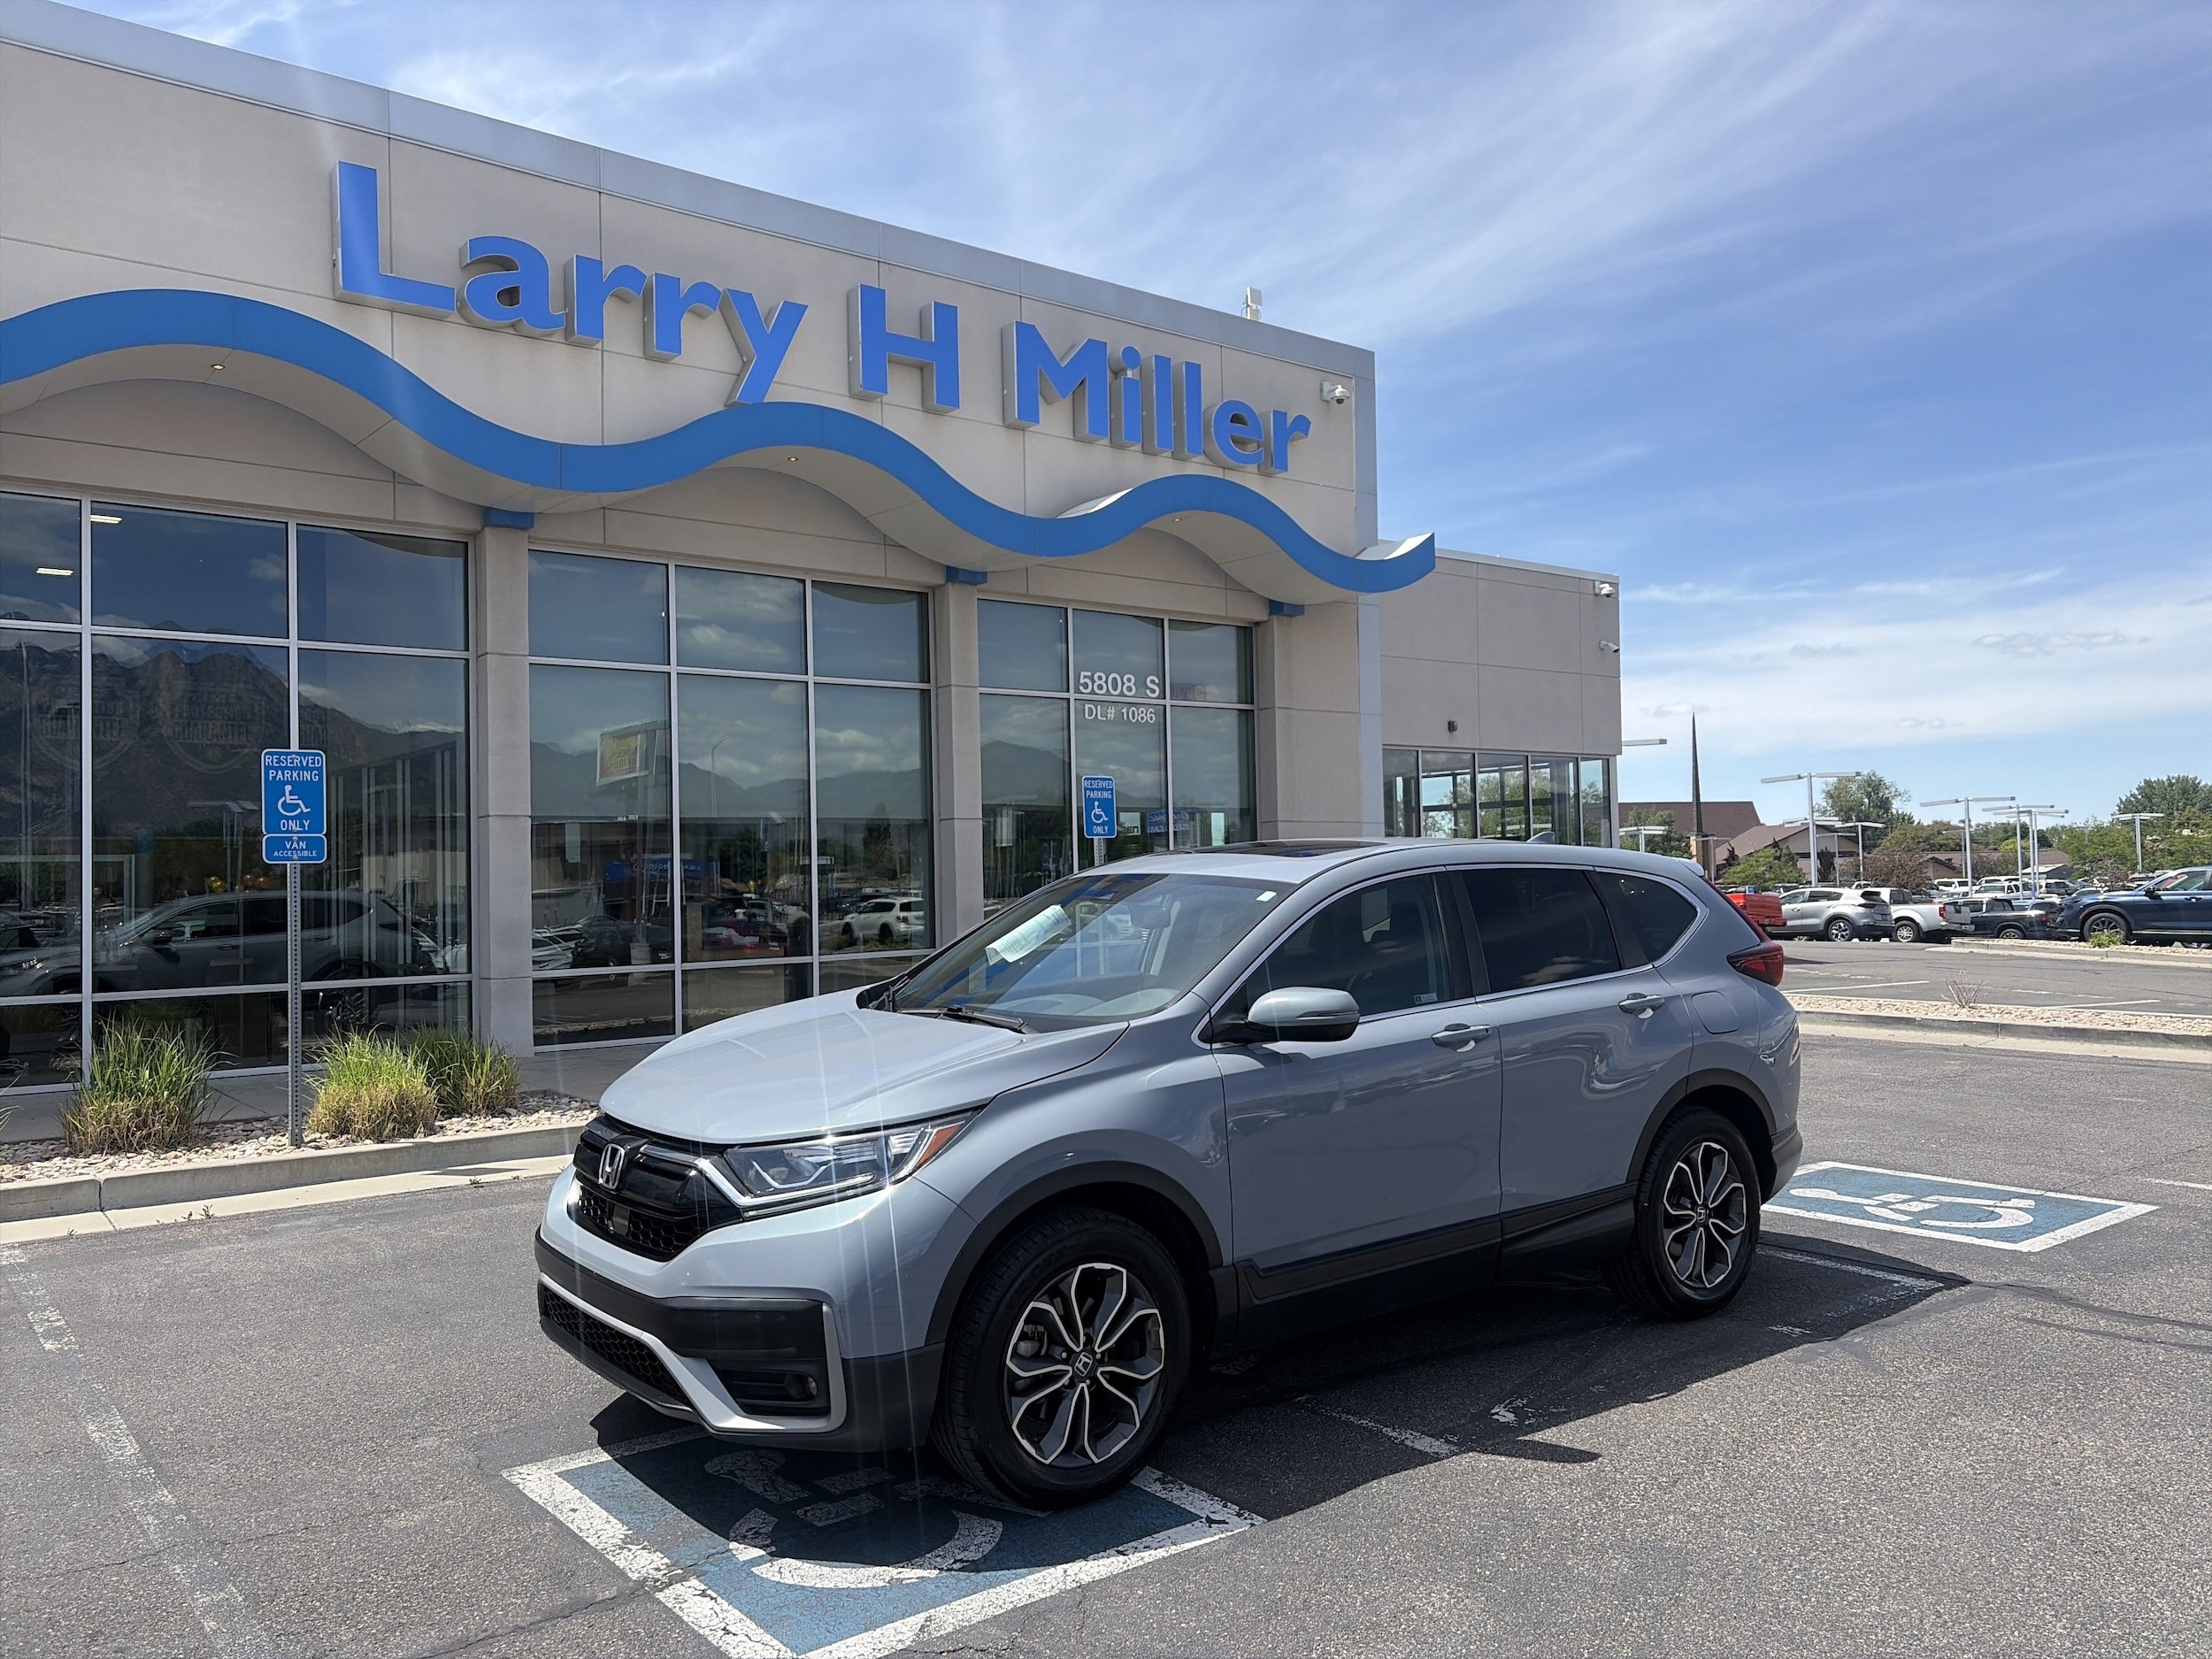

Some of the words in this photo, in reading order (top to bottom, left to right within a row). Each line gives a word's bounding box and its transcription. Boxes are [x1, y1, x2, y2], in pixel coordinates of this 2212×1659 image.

[331, 159, 809, 407] Larry
[848, 283, 960, 413] H
[1002, 320, 1312, 472] Miller
[1079, 671, 1136, 696] 5808
[1146, 675, 1160, 698] S
[1084, 703, 1115, 721] DL#
[1121, 707, 1156, 724] 1086
[265, 755, 322, 767] RESERVED
[269, 770, 319, 782] PARKING
[1084, 780, 1113, 788] RESERVED
[1086, 790, 1112, 799] PARKING
[280, 819, 311, 831] ONLY
[1093, 826, 1109, 834] ONLY
[285, 841, 306, 849] VAN
